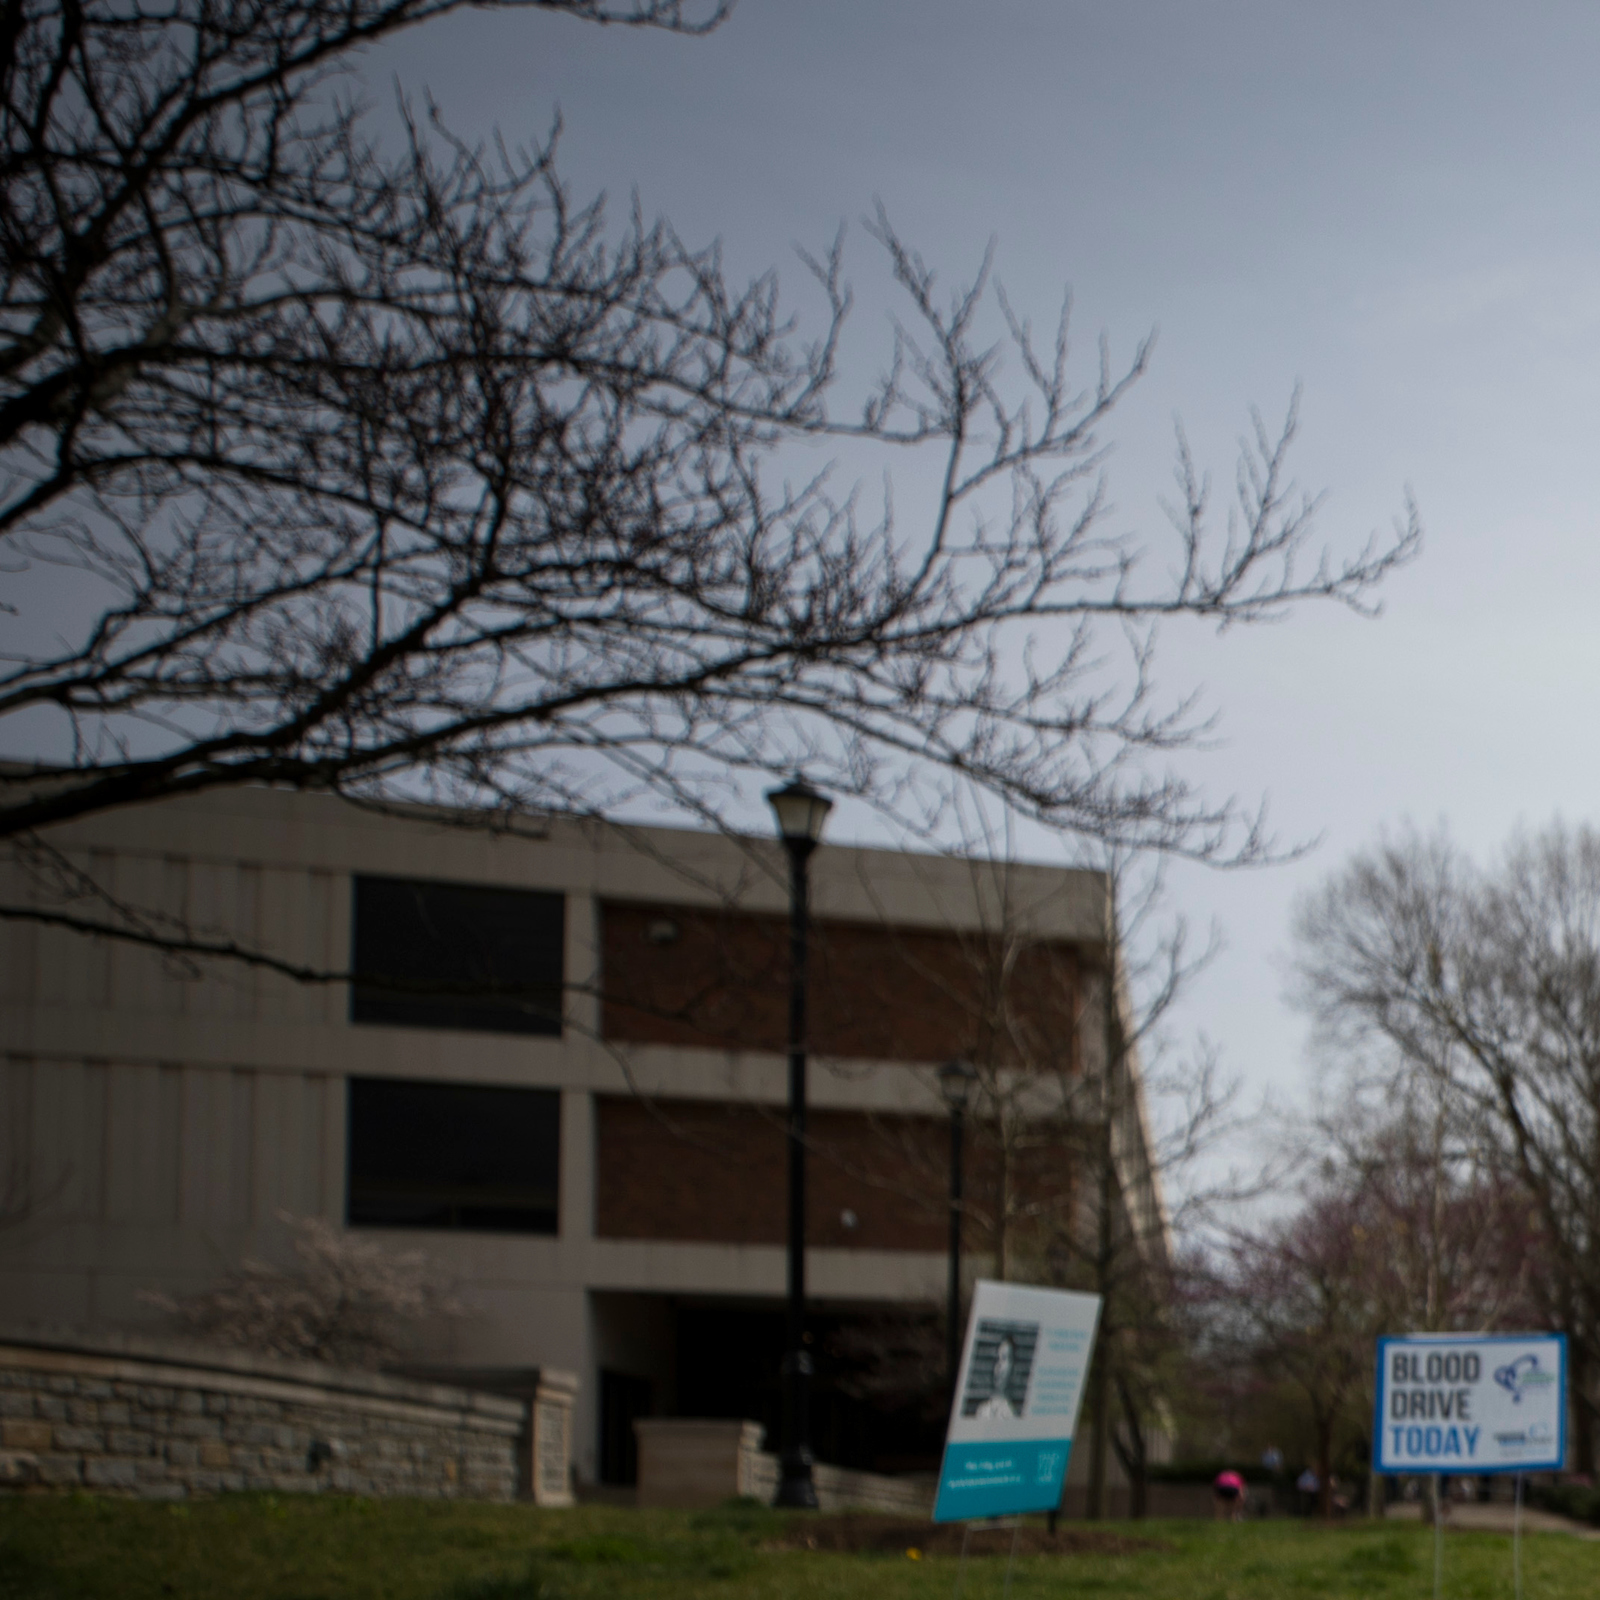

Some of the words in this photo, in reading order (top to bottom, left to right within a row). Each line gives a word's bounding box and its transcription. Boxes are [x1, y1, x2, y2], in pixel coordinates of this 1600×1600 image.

[1391, 1351, 1481, 1384] BLOOD
[1389, 1388, 1471, 1420] DRIVE
[1389, 1425, 1480, 1457] TODAY
